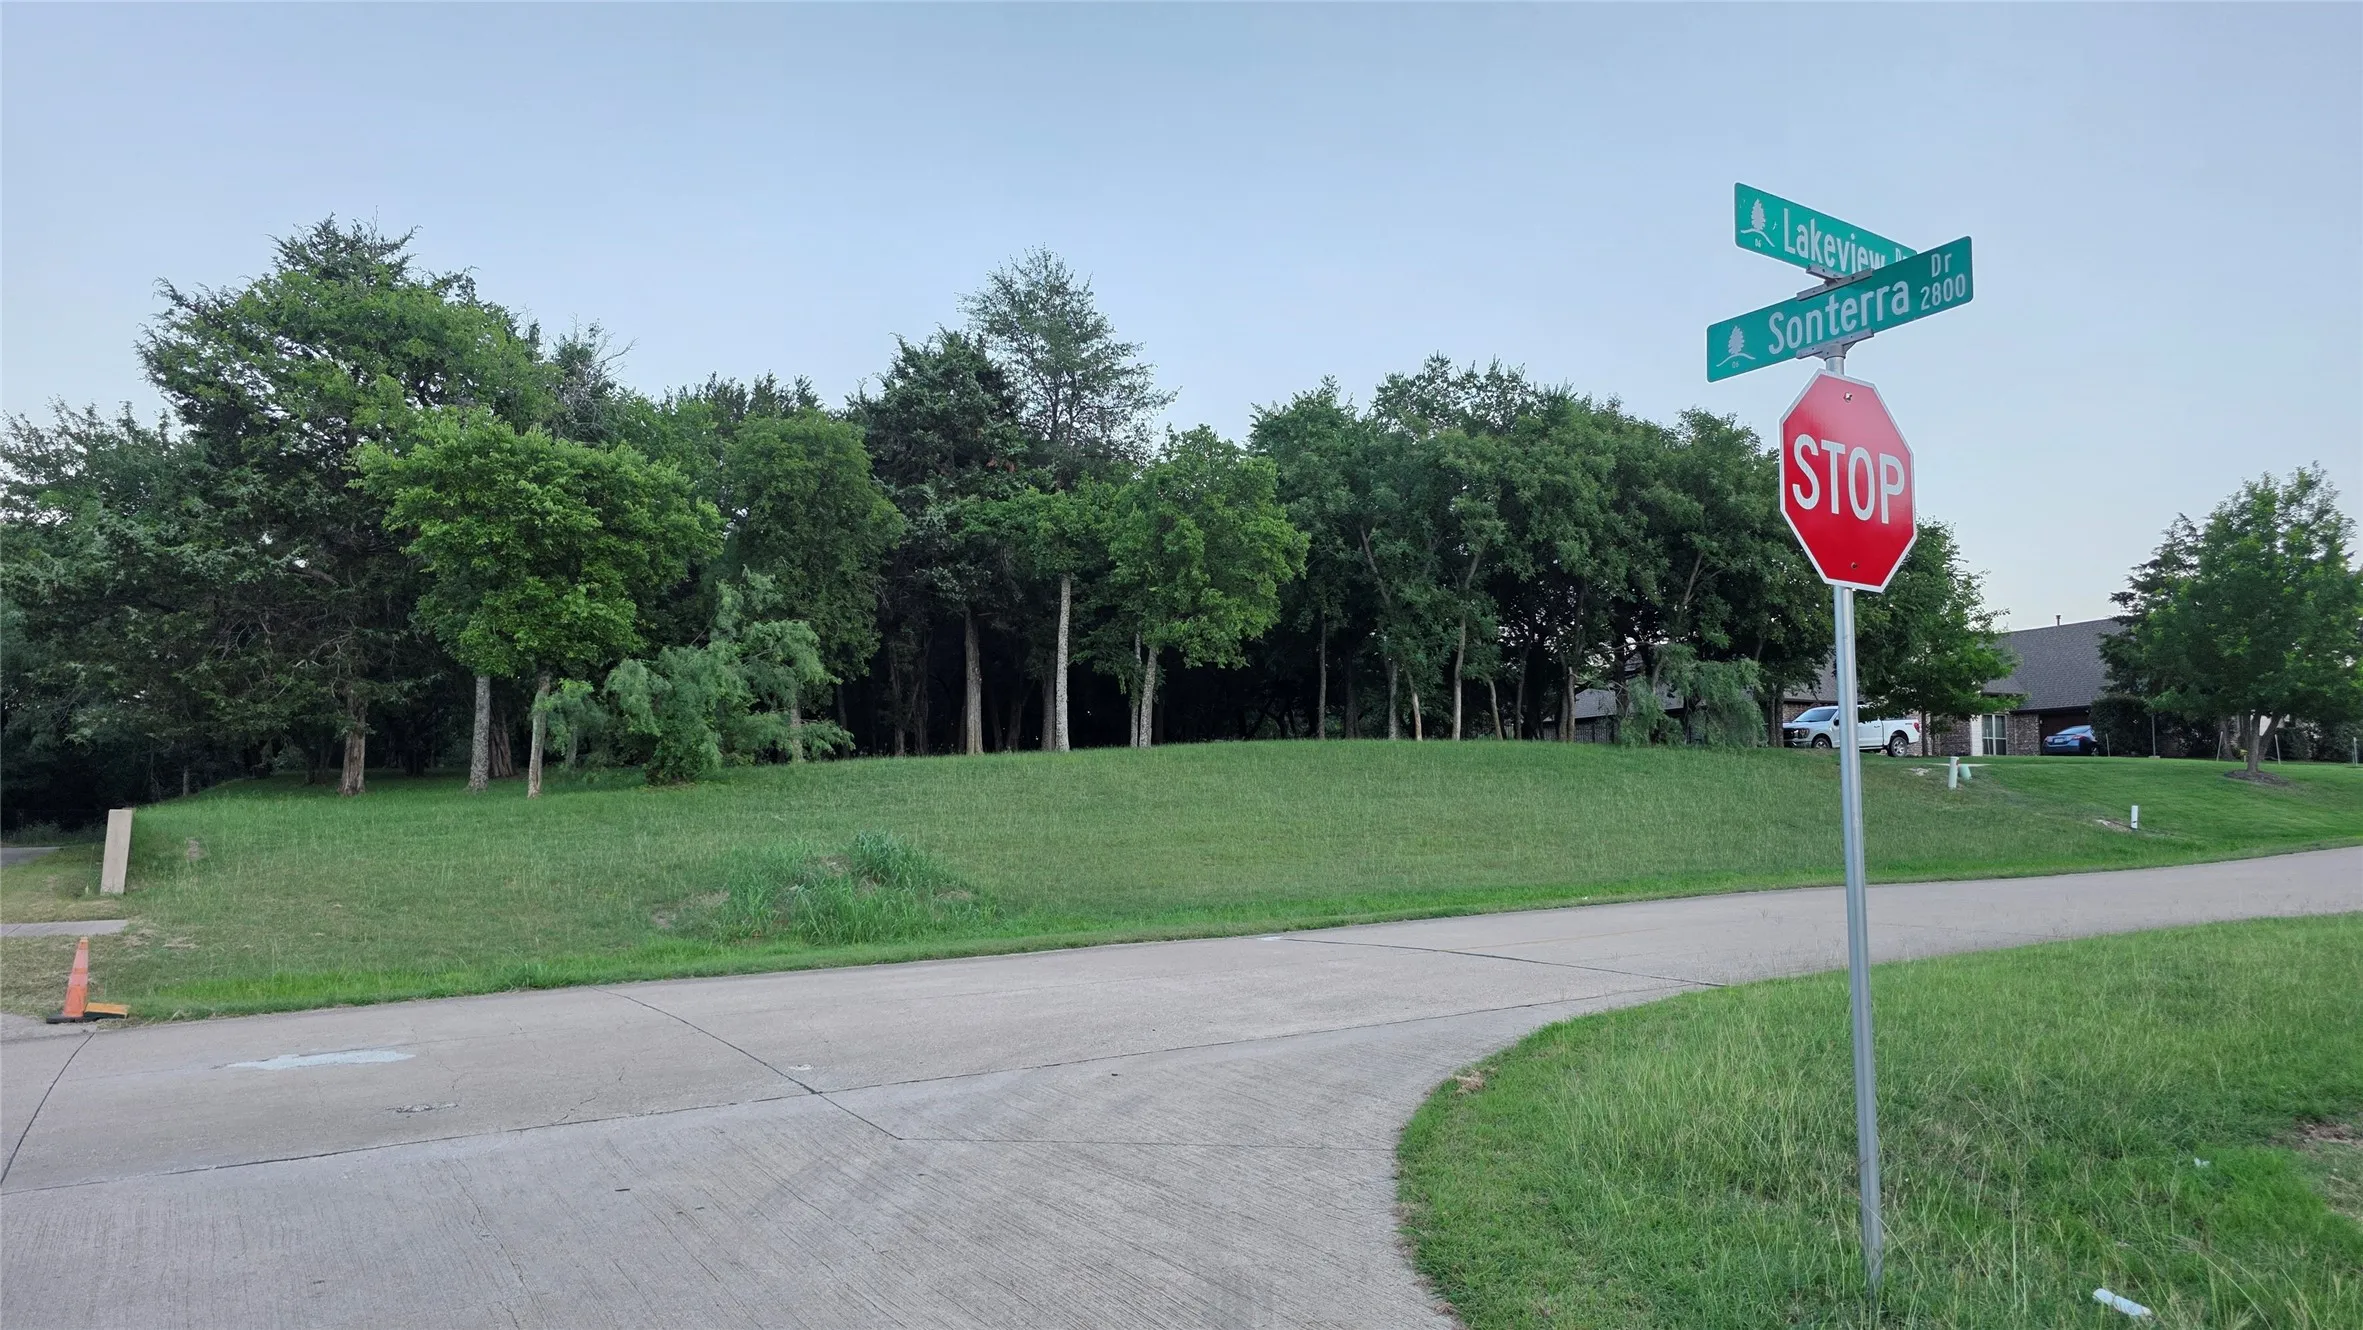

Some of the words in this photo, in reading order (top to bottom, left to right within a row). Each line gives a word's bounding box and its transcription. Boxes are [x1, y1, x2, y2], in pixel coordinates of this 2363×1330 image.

[1783, 207, 1886, 274] Lakeview
[1768, 280, 1909, 356] Sonterra
[1931, 251, 1952, 278] Dr
[1920, 273, 1966, 311] 2800
[1792, 433, 1905, 525] STOP
